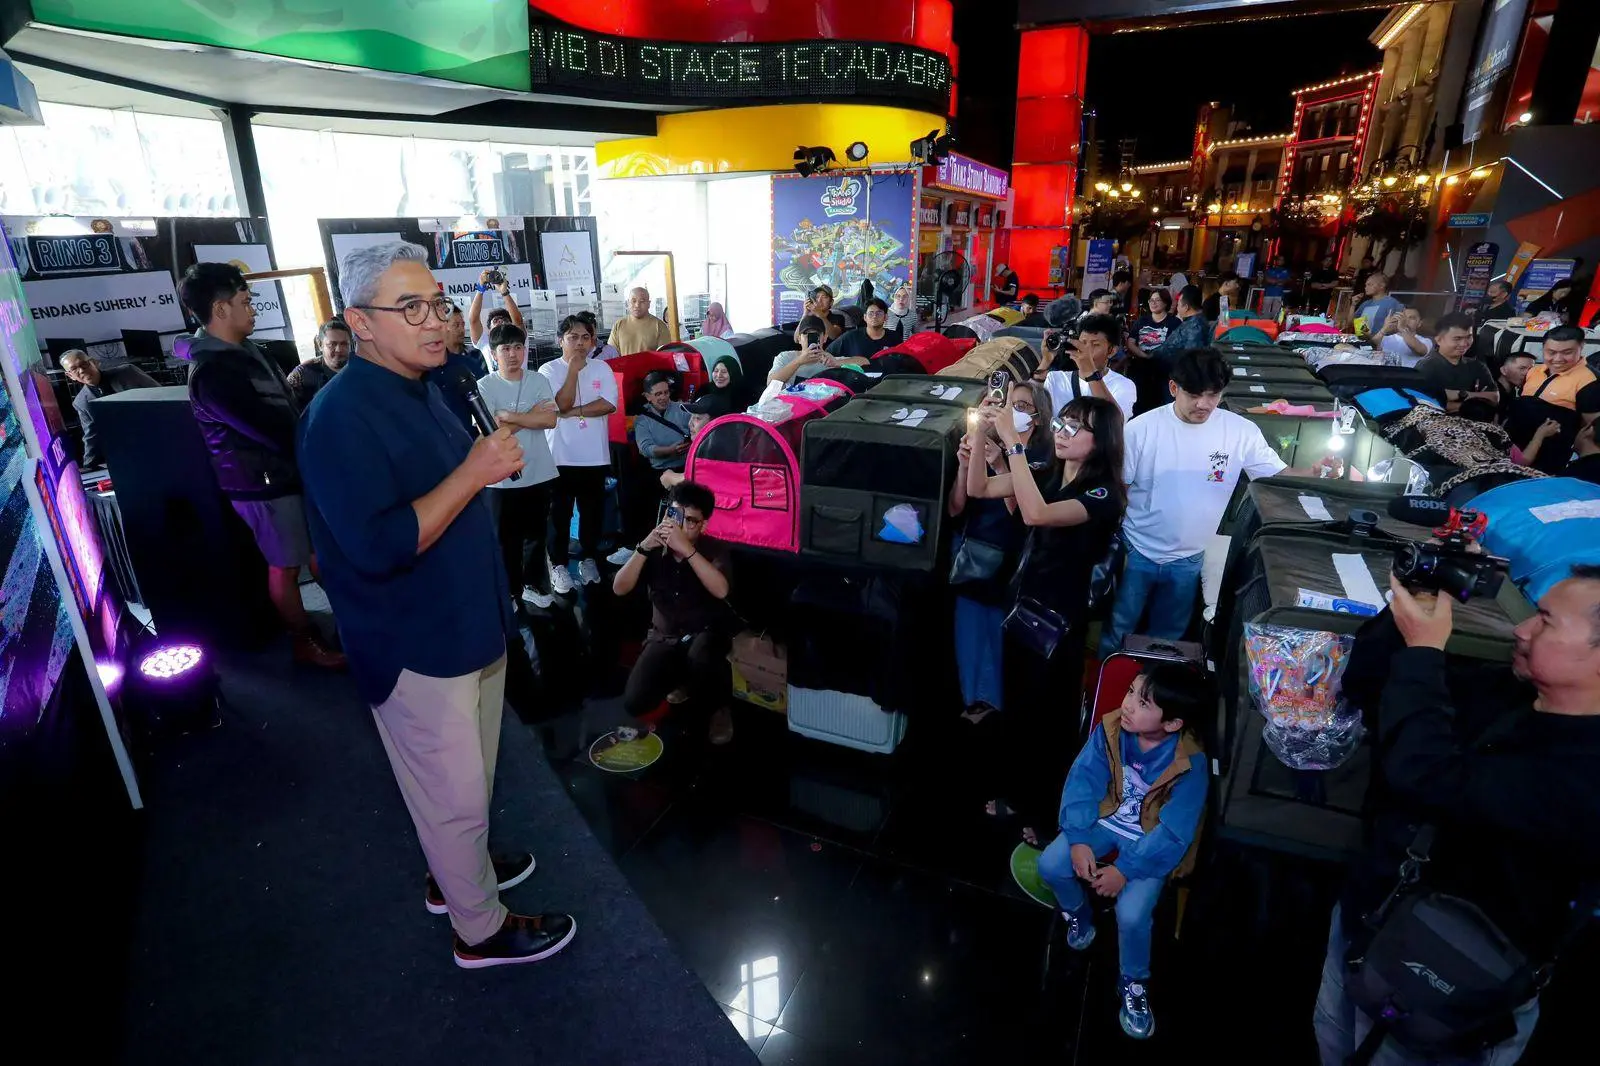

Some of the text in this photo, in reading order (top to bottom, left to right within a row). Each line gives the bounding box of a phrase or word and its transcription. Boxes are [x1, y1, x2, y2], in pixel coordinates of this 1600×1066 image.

[598, 40, 626, 78] DI
[641, 46, 760, 82] STAGE
[36, 237, 114, 268] RING 3
[457, 242, 501, 262] RING 4
[518, 278, 531, 289] LH
[32, 302, 92, 321] ENDANG
[94, 296, 147, 314] SUHERLY
[159, 293, 175, 306] SH
